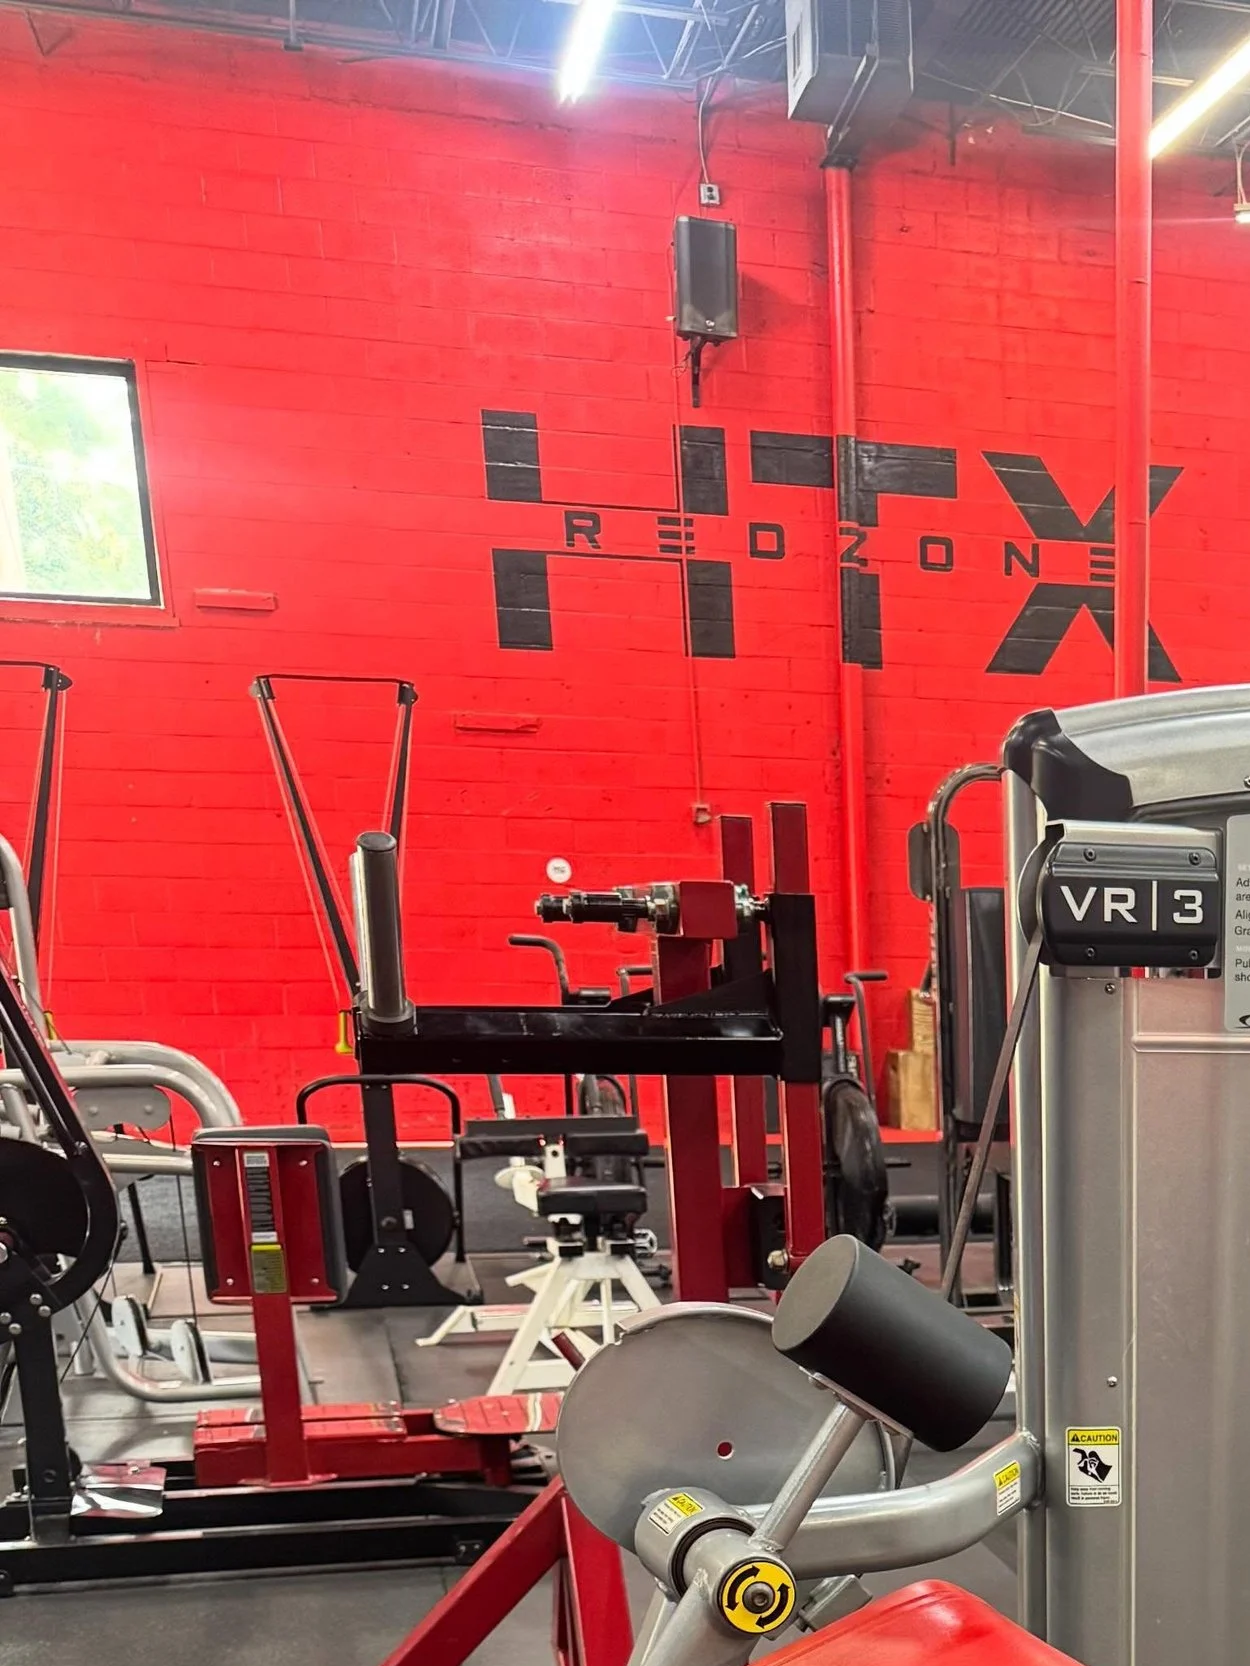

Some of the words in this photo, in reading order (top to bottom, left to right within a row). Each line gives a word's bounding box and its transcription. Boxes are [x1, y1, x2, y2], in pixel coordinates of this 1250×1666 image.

[1060, 885, 1138, 923] VR
[1172, 889, 1203, 924] 3
[1080, 1434, 1118, 1442] CAUTION
